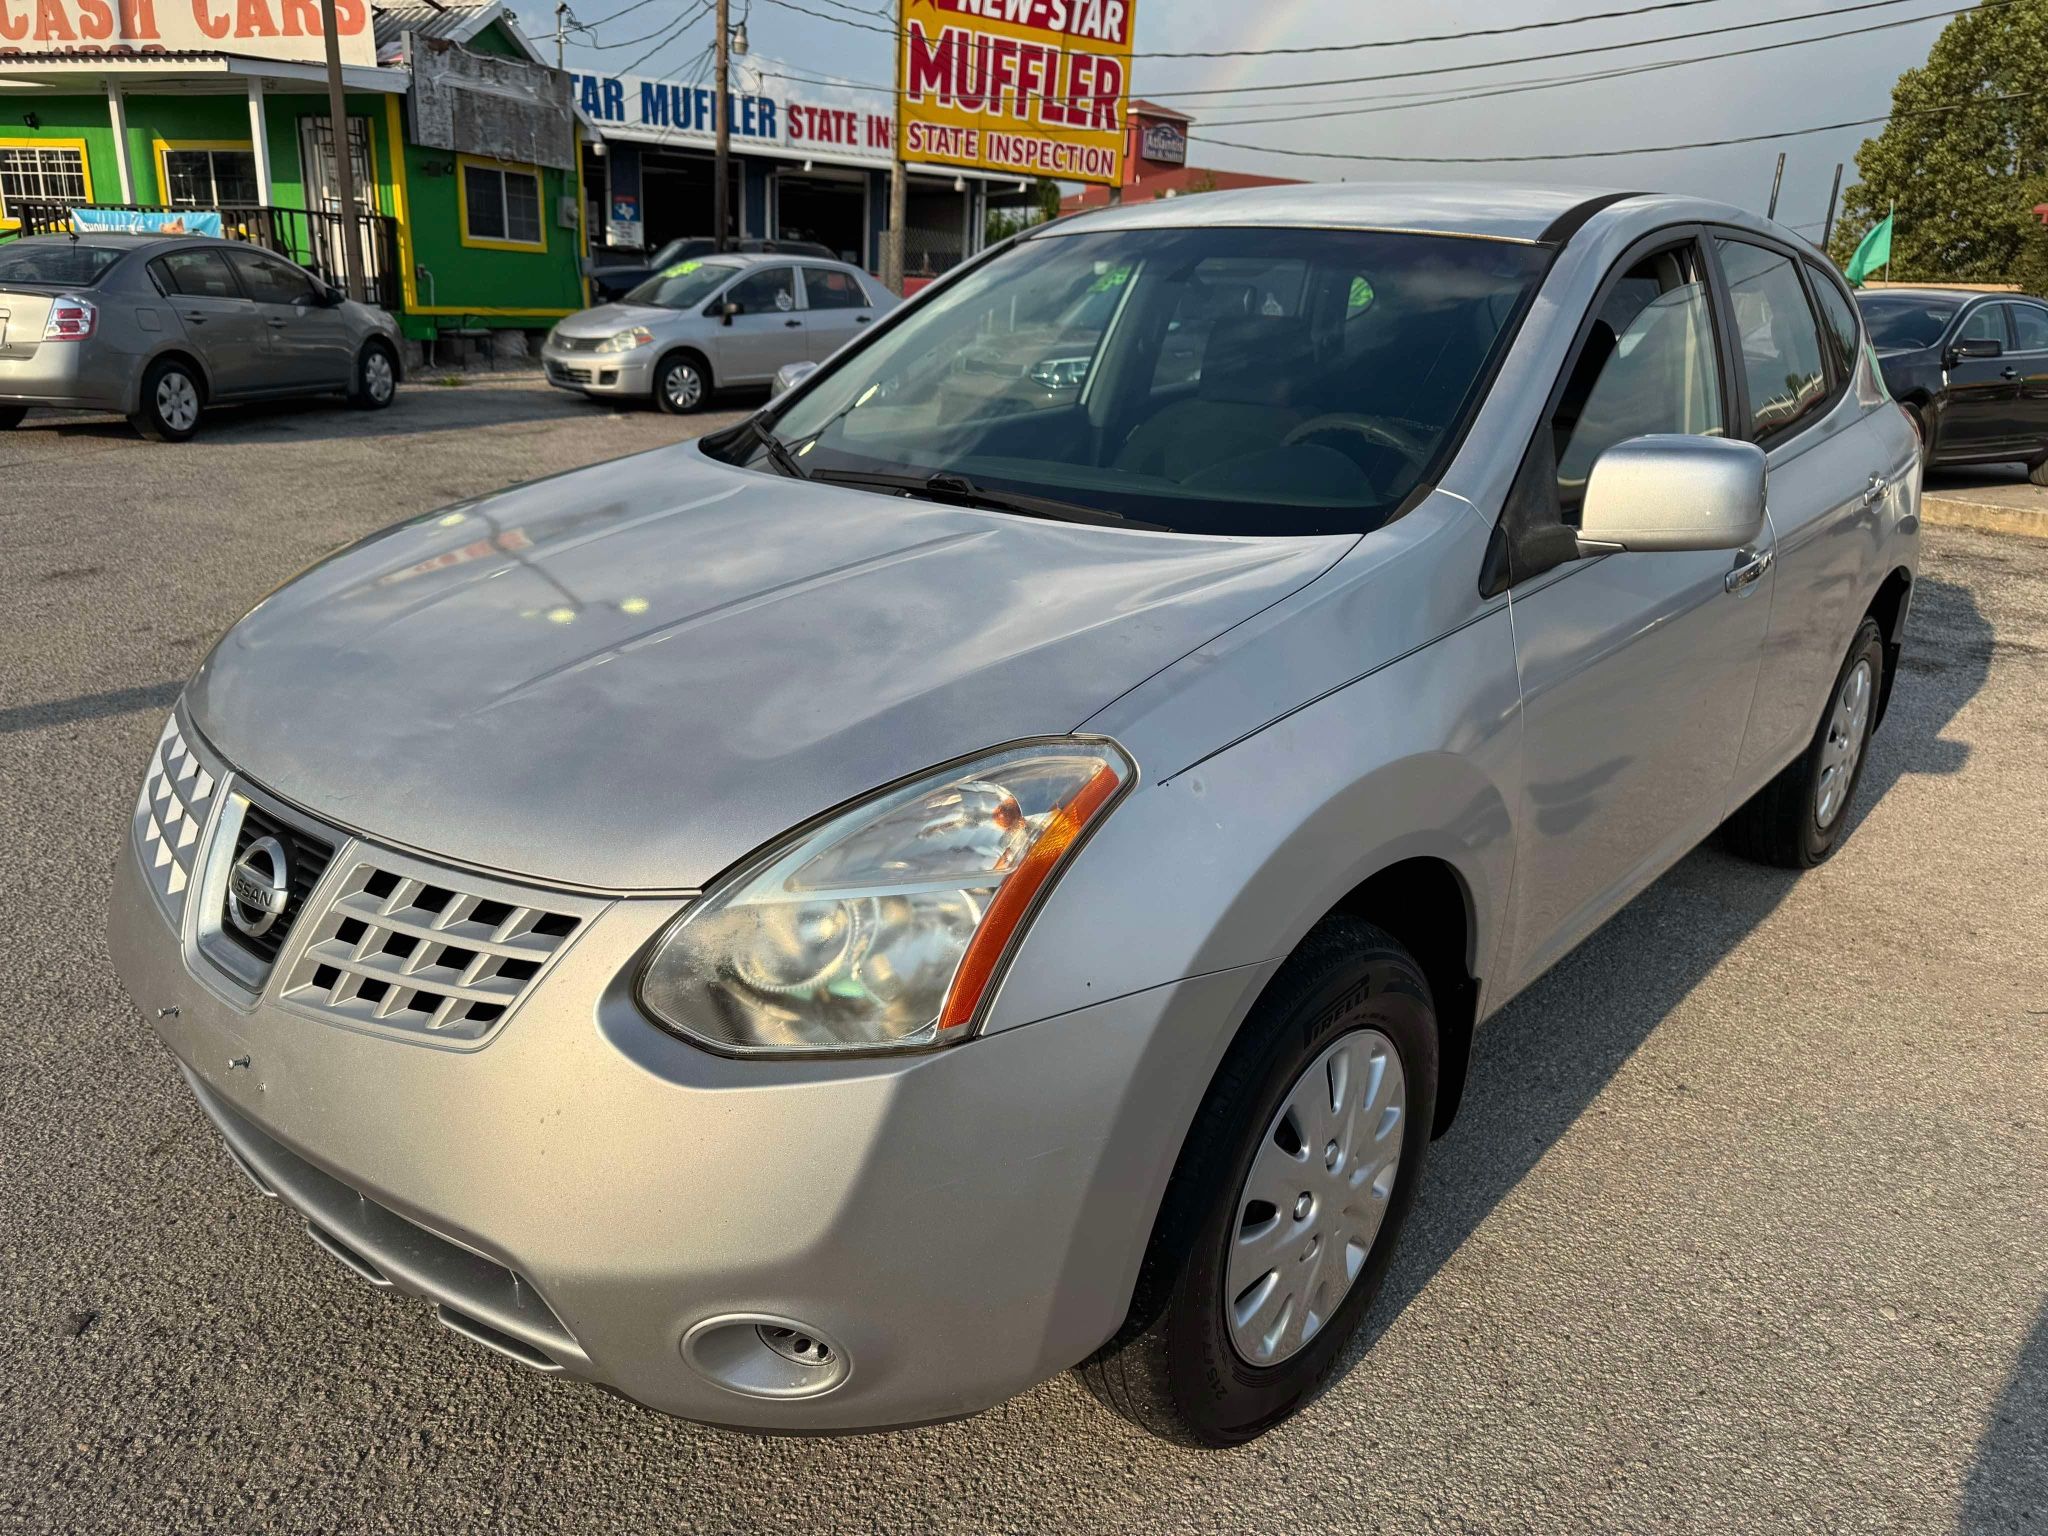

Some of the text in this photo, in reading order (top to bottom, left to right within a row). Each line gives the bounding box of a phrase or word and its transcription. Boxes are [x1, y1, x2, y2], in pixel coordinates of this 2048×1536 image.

[908, 19, 1123, 133] MUFFLER
[788, 104, 858, 146] STATE
[908, 121, 1117, 178] STATE INSPECTION
[1303, 974, 1370, 1050] PIRELLI
